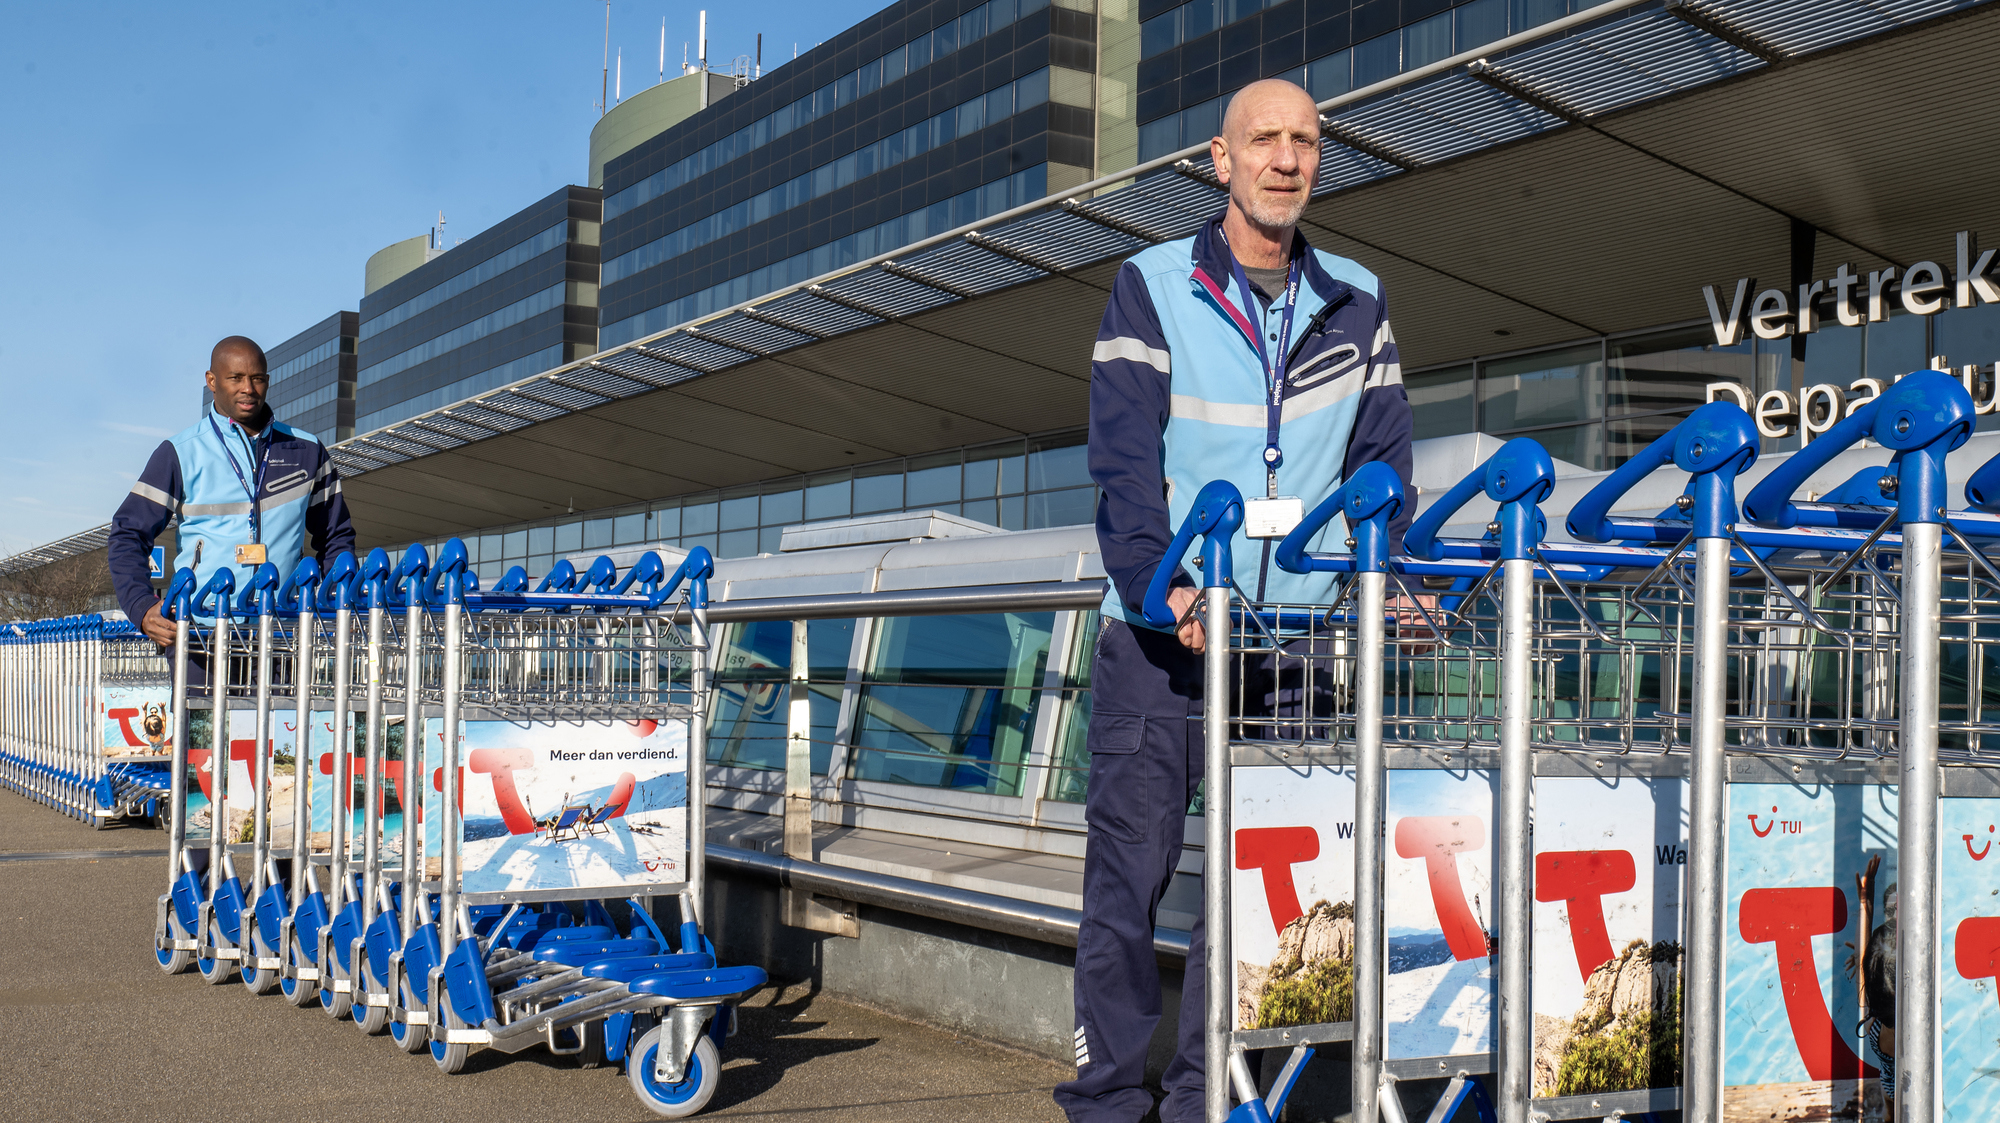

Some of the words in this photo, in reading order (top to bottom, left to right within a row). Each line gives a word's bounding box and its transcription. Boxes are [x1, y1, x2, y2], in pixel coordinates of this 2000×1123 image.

[1288, 281, 1297, 306] Schiphol
[1273, 378, 1283, 406] Schiphol
[1705, 355, 2000, 448] epau
[550, 750, 586, 761] Meer
[589, 749, 613, 760] dan
[617, 748, 678, 760] verdiend.
[1780, 820, 1802, 835] TUI
[662, 862, 676, 870] TUI
